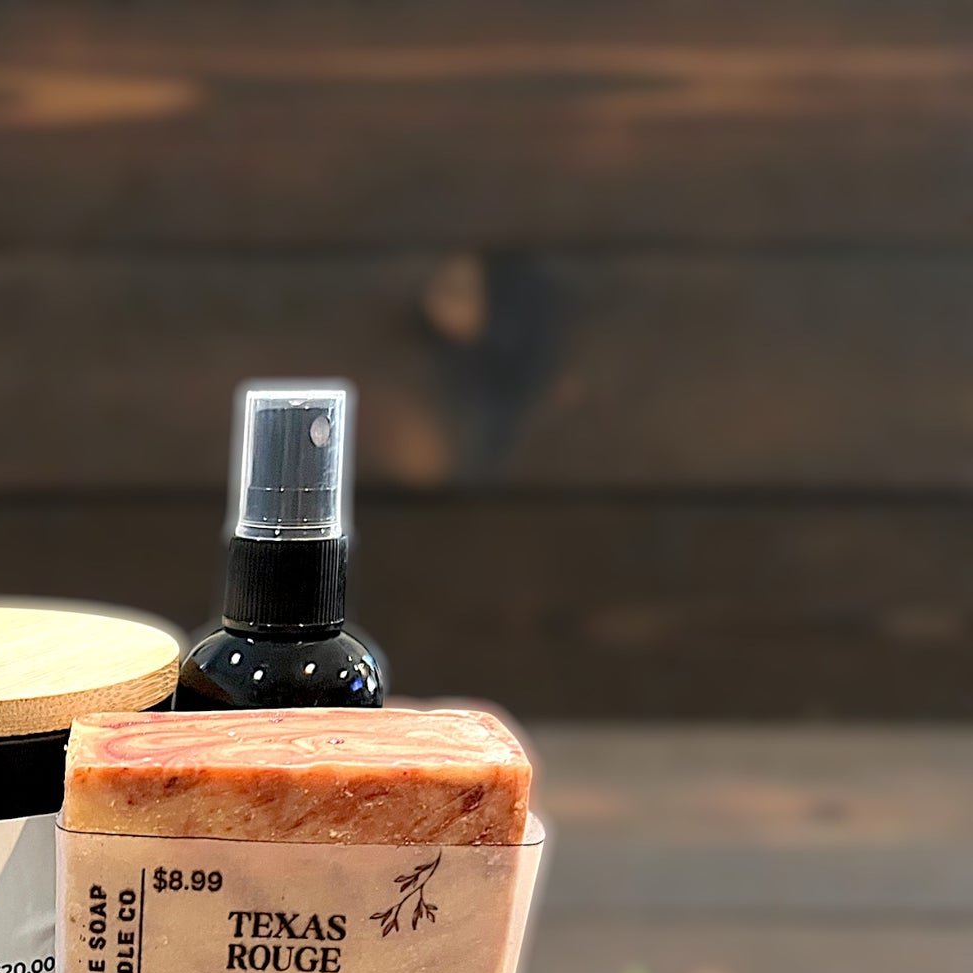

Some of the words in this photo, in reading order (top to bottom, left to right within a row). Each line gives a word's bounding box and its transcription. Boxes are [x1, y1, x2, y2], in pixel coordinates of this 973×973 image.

[153, 867, 224, 893] $8.99
[88, 884, 107, 951] SOAP
[118, 889, 136, 922] CO
[228, 910, 347, 941] TEXAS
[226, 943, 342, 973] ROUGE
